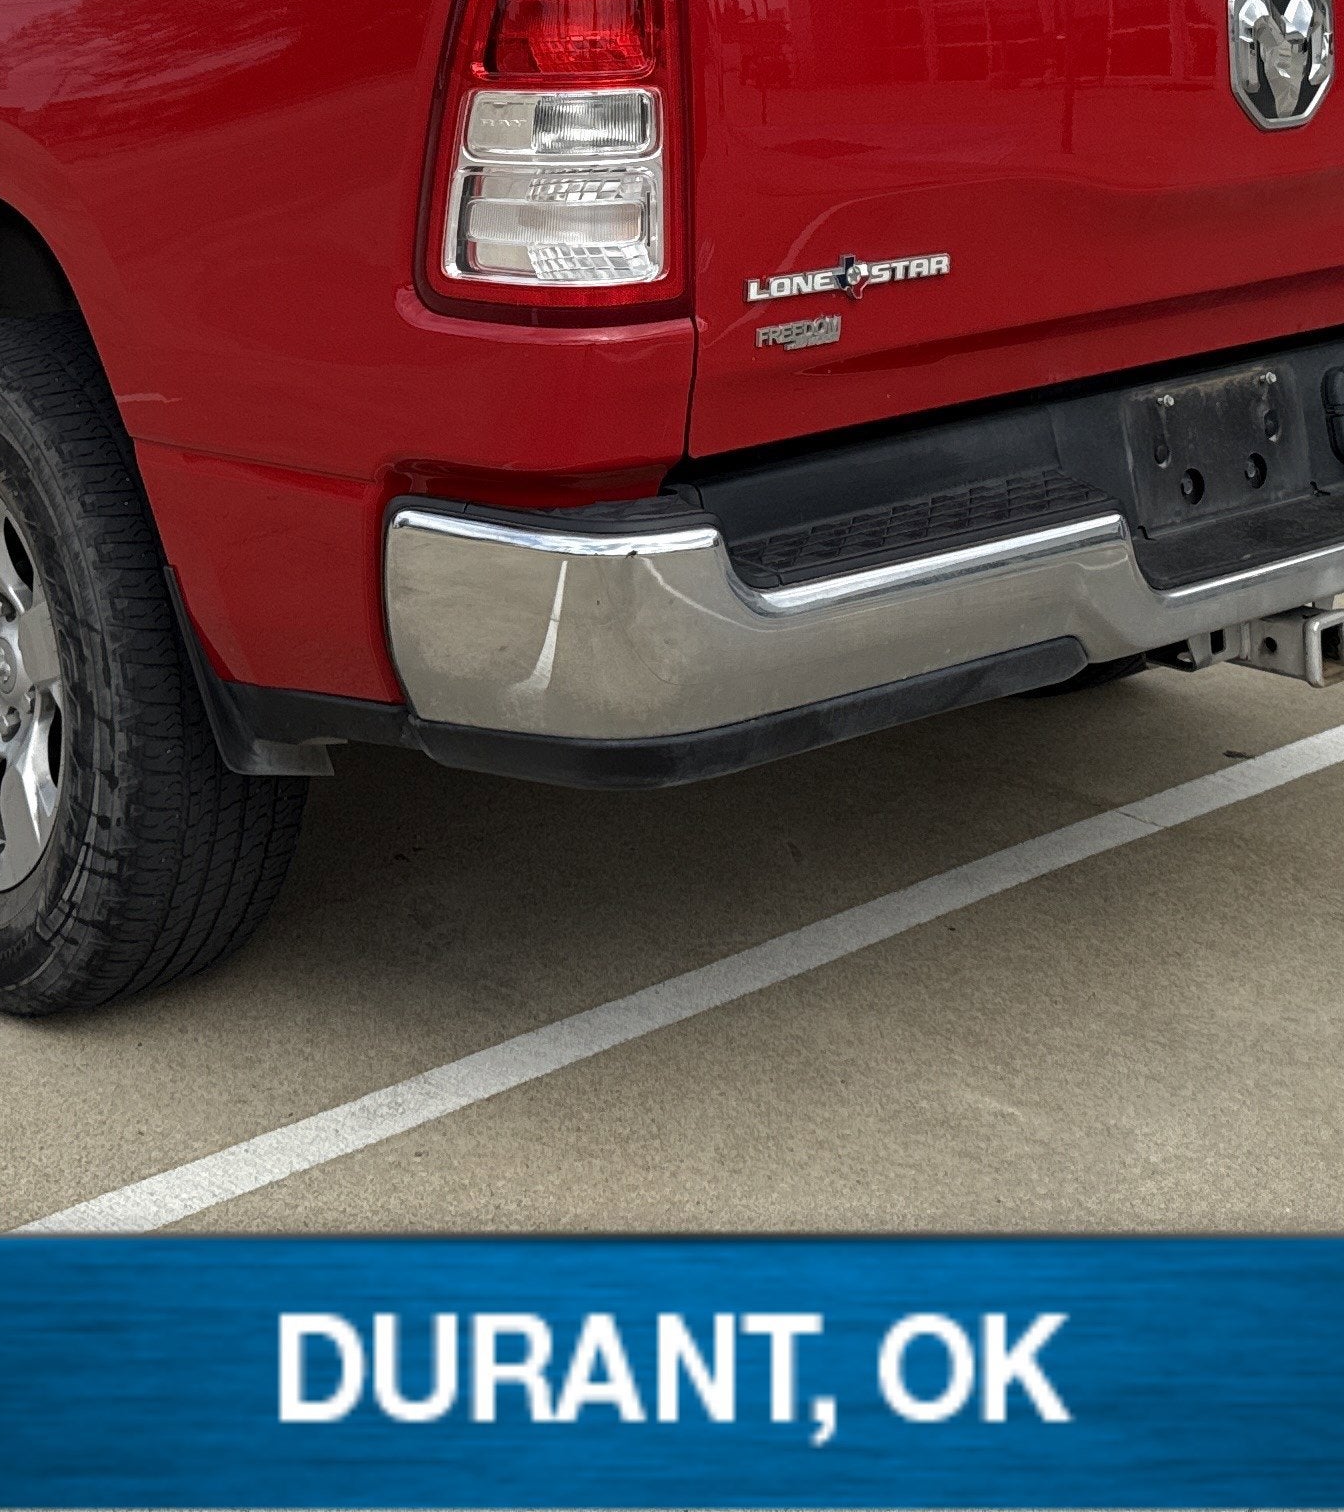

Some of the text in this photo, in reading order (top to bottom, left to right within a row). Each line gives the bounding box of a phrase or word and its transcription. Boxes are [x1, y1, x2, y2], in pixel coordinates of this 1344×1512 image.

[746, 254, 951, 302] LONE STAR
[756, 315, 842, 348] FREEDOM
